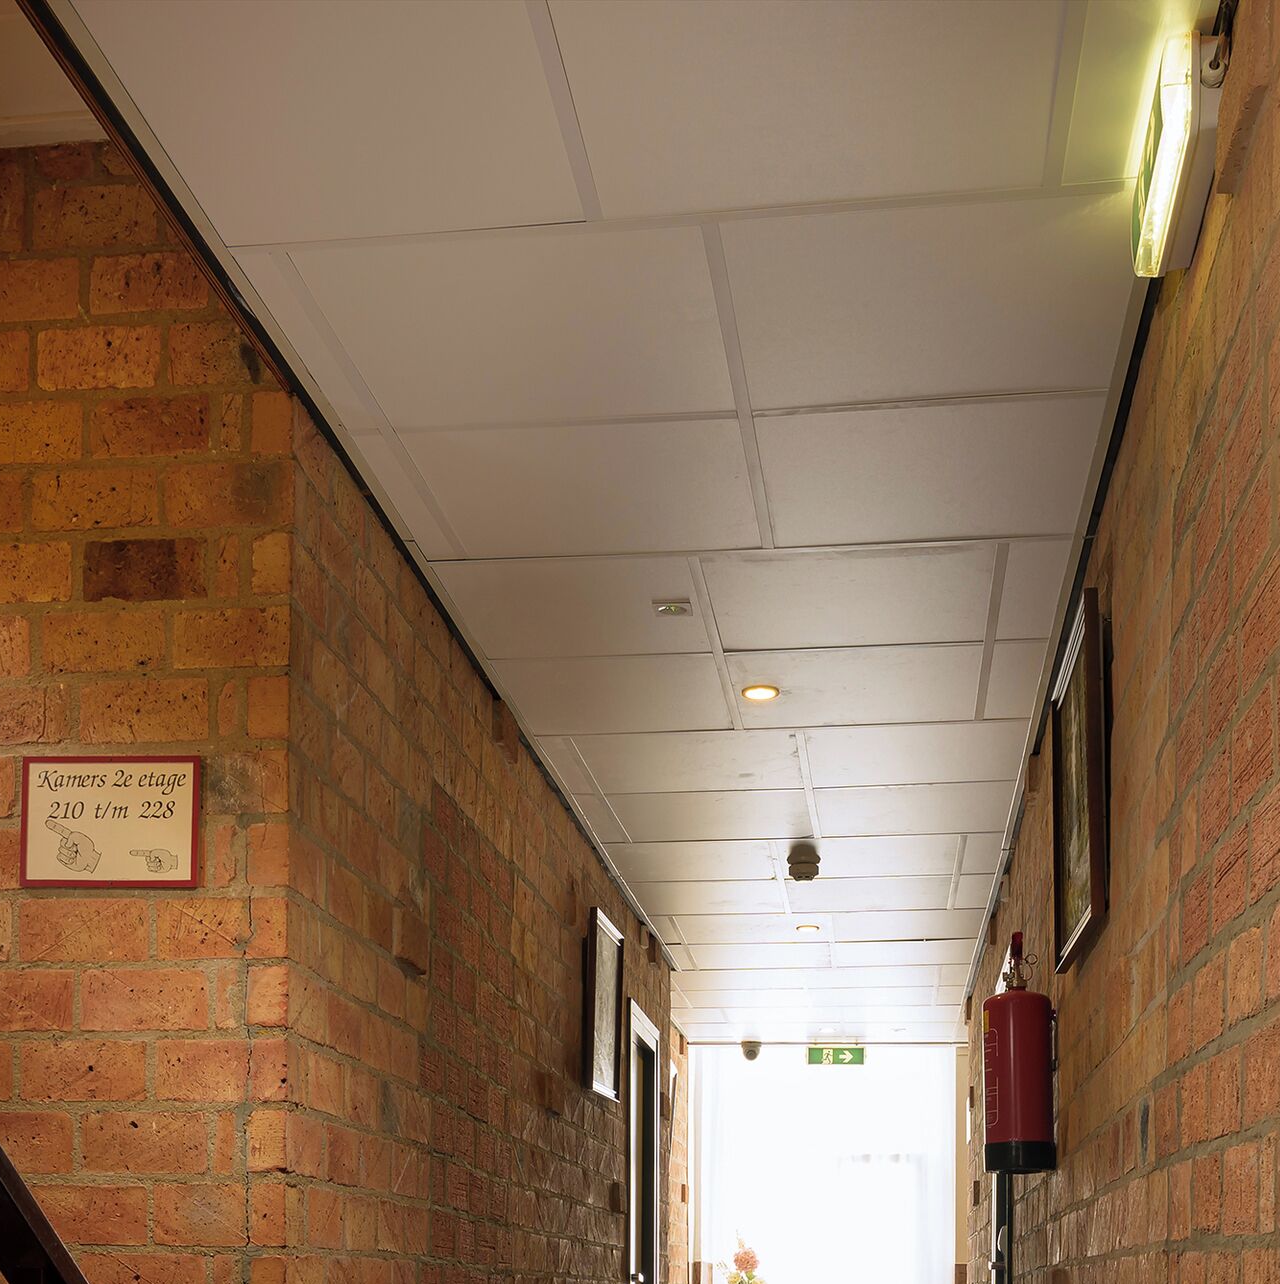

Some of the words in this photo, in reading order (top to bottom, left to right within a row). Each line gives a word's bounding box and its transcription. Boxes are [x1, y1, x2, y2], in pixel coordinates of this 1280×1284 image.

[37, 770, 107, 791] Kamers
[111, 770, 133, 788] 2e
[138, 772, 187, 795] etage
[47, 801, 85, 819] 210
[94, 801, 129, 819] t/m
[138, 801, 176, 818] 228
